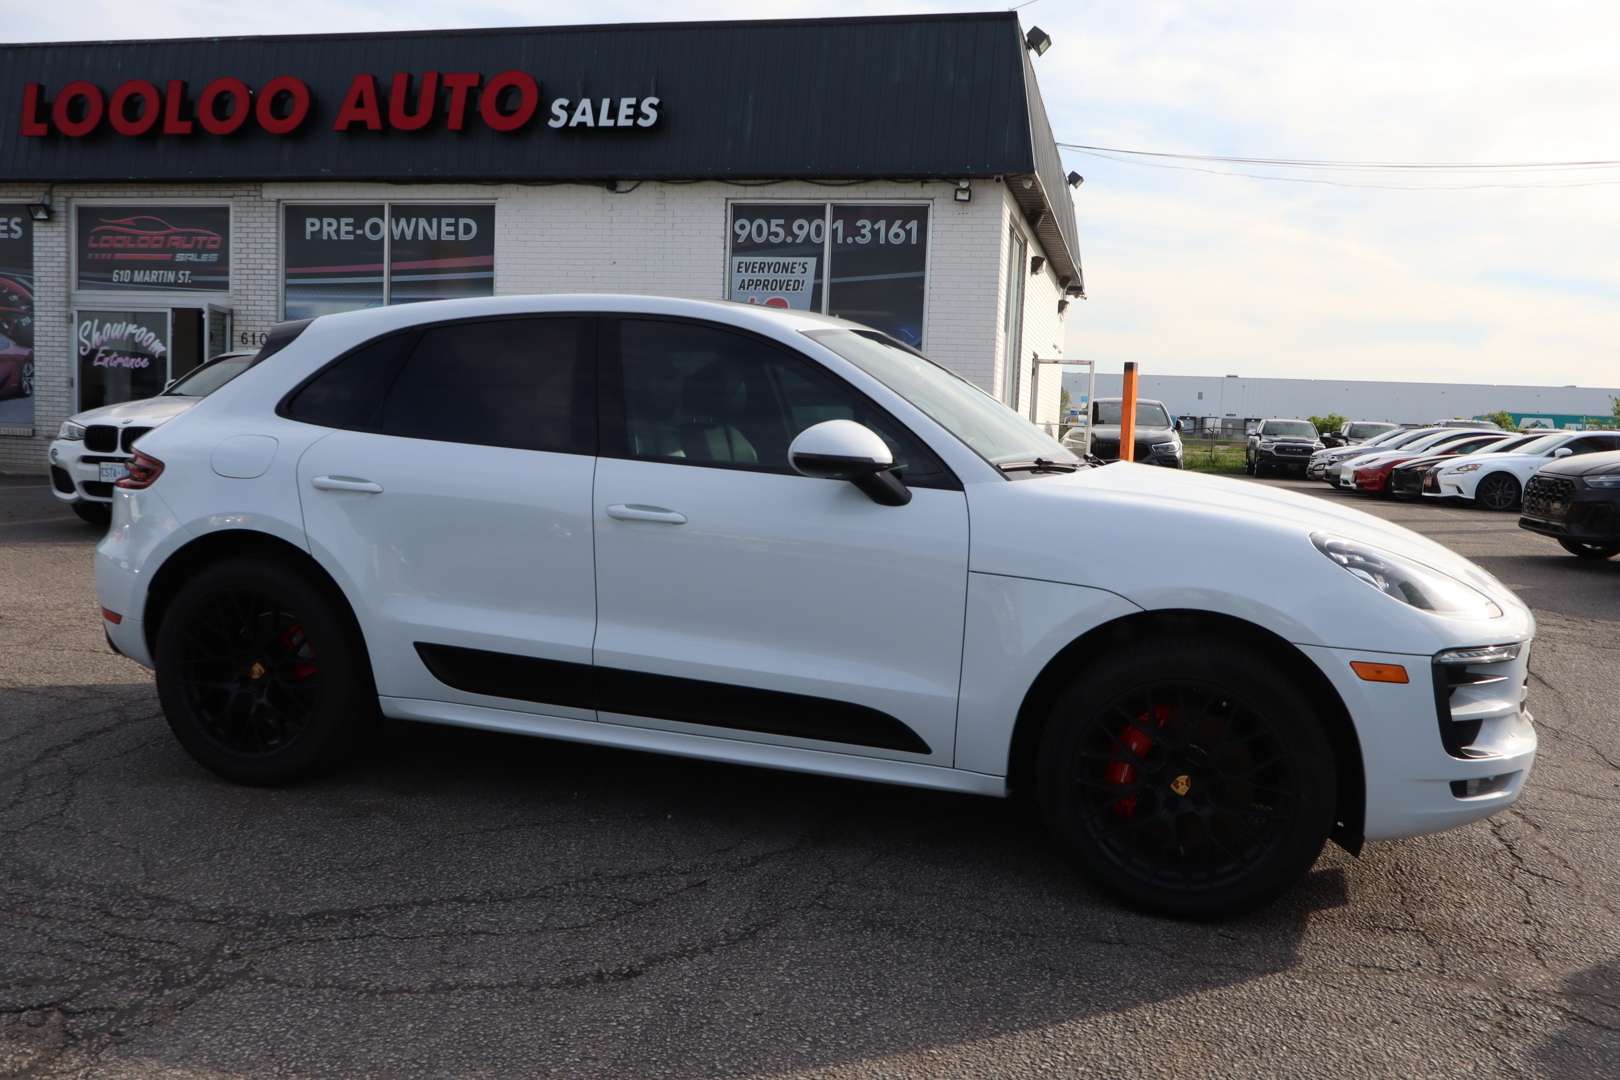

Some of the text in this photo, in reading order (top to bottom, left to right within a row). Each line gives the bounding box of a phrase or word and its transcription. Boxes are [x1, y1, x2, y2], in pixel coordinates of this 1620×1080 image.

[21, 70, 661, 137] LOOLOO AUTO SALES
[305, 217, 478, 241] PRE-OWNED
[733, 218, 919, 245] 905.901.3161
[88, 236, 223, 249] LOOLOO AUTO
[175, 252, 220, 262] SALES
[736, 261, 808, 275] EVERYONE'S
[112, 270, 192, 283] 610 MARTIN ST.
[738, 278, 805, 292] APPROVED!
[79, 318, 167, 358] Showroom
[240, 332, 269, 346] 610
[93, 346, 150, 369] Entrance
